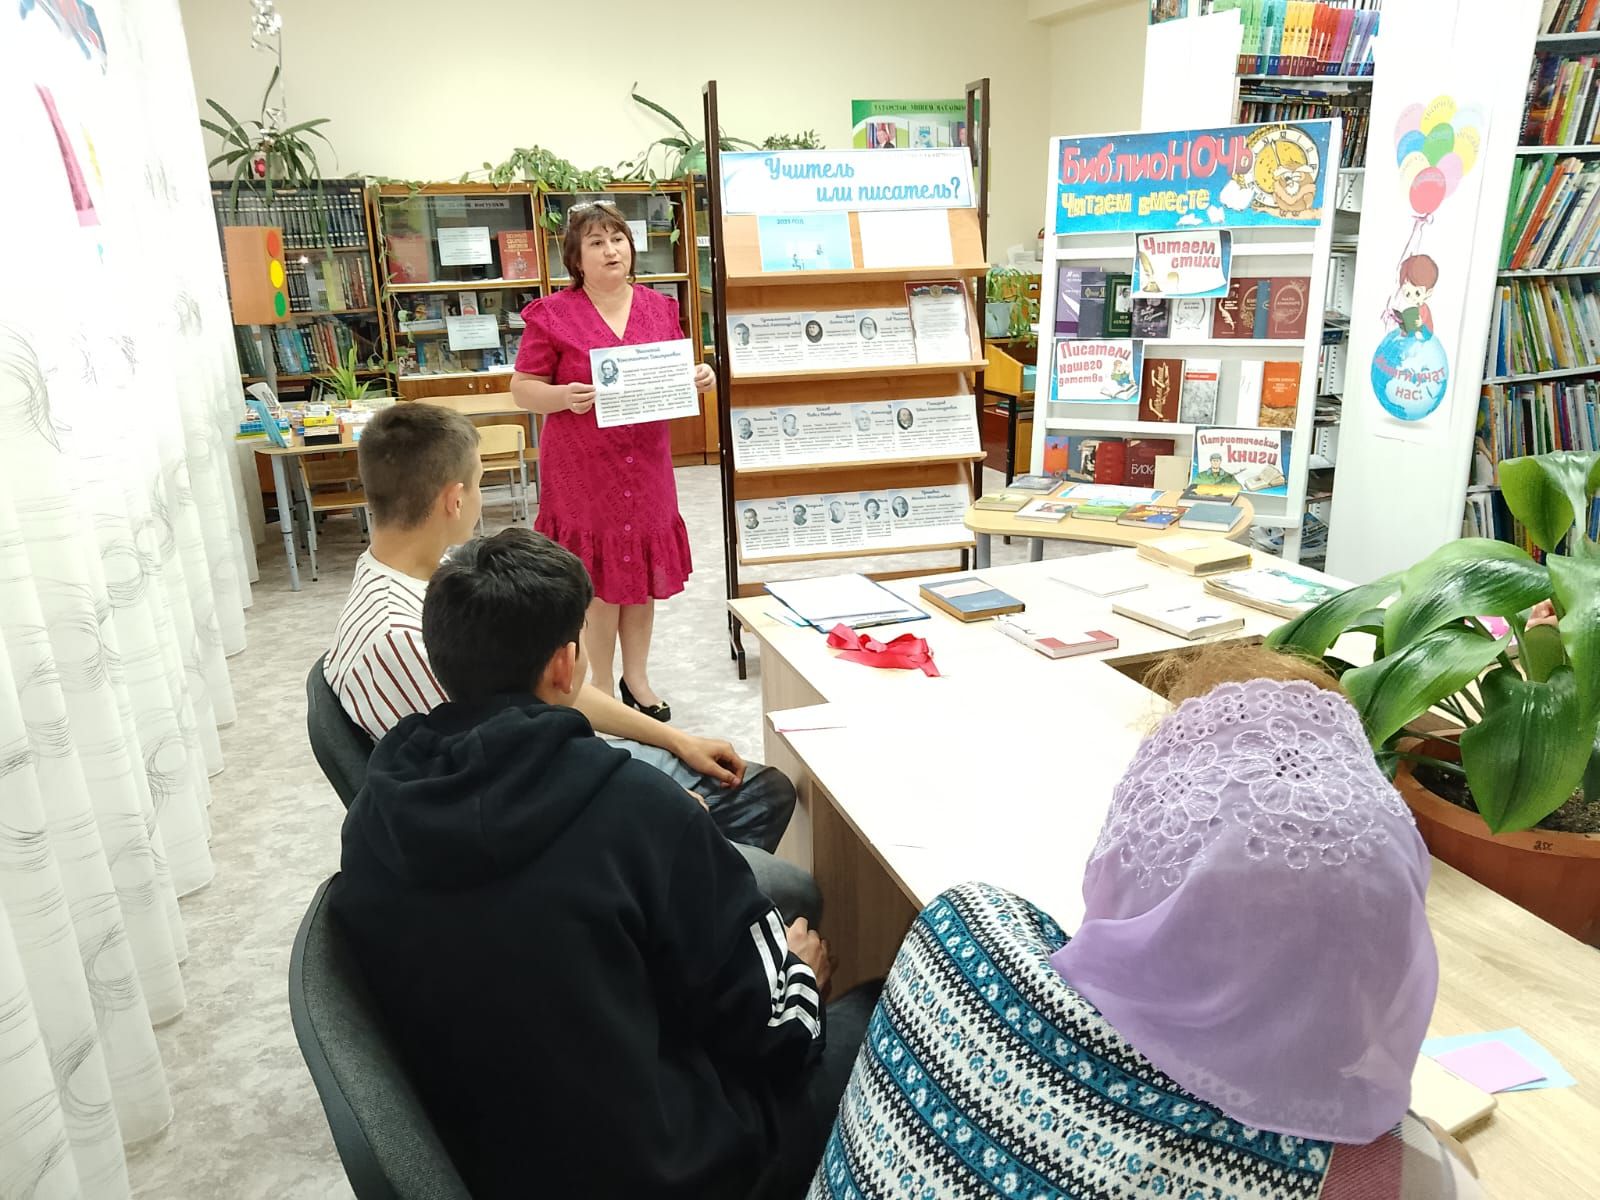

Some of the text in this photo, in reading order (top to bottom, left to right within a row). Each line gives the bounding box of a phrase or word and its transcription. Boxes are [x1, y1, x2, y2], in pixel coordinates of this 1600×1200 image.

[765, 158, 854, 180] Учитель
[816, 177, 960, 202] или писатель?
[1144, 237, 1215, 255] Читаем
[1171, 254, 1221, 269] стихи
[1060, 341, 1131, 360] Писатели
[1059, 360, 1103, 374] нашего
[1058, 375, 1104, 387] детства
[1200, 434, 1279, 450] Патриотические
[1227, 445, 1278, 465] книги
